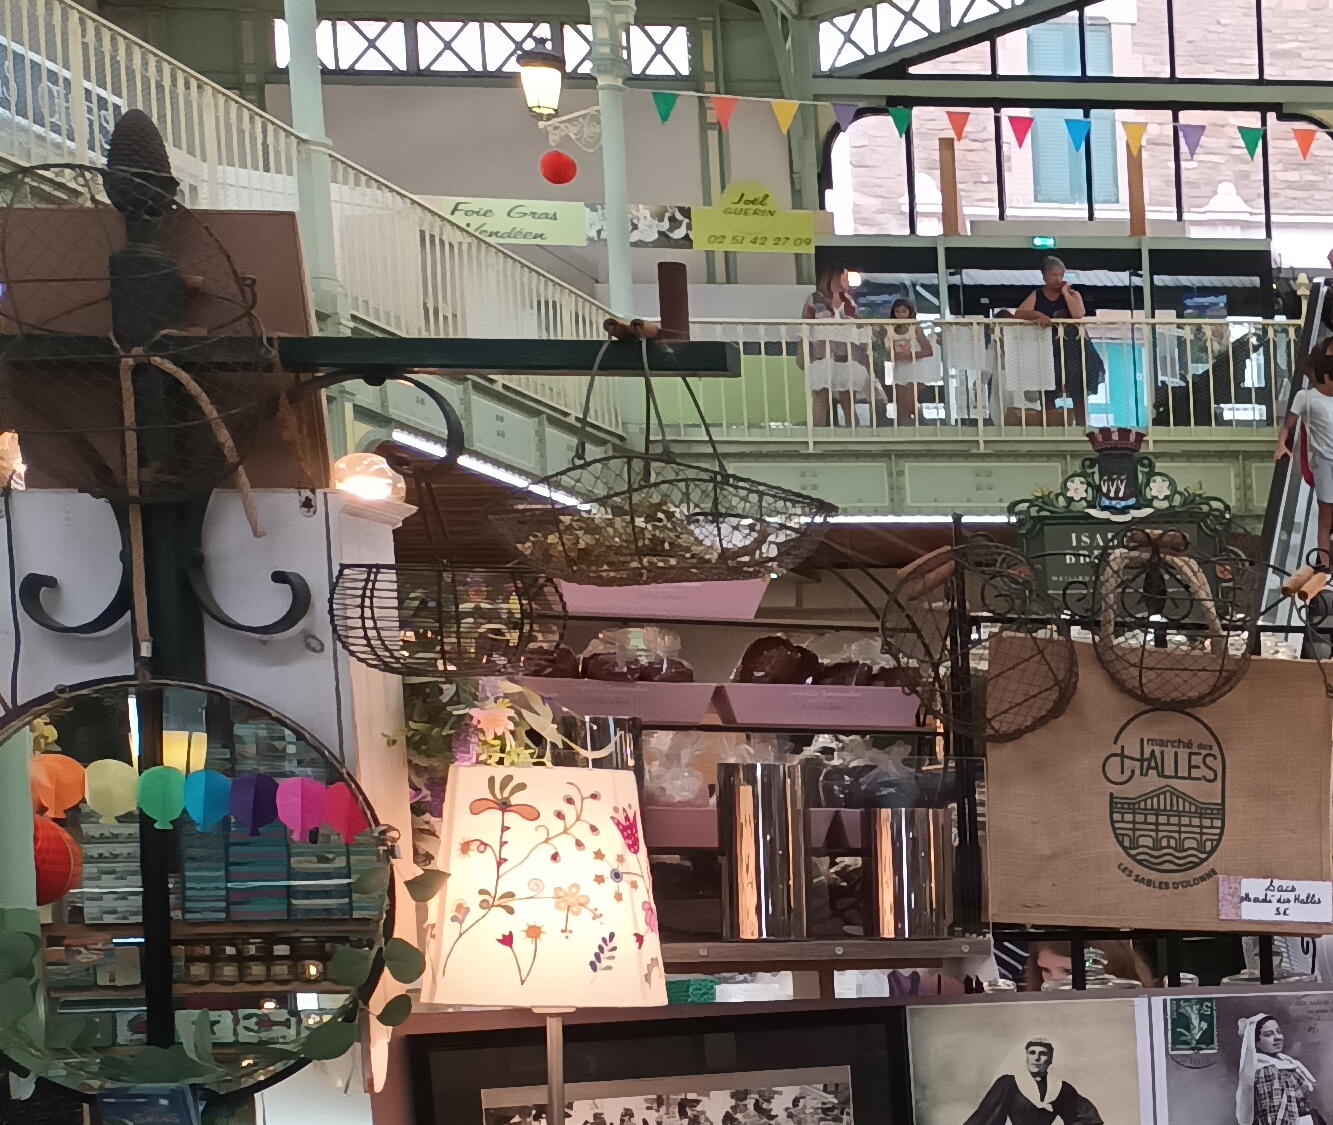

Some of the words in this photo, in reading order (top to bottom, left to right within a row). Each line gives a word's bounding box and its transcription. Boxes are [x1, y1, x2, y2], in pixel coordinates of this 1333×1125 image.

[449, 201, 496, 218] Foie
[505, 203, 559, 221] Gras
[722, 206, 778, 218] GUERIN
[1146, 738, 1194, 750] marché
[1196, 742, 1213, 751] des
[1101, 738, 1218, 786] HALLES
[1117, 862, 1134, 878] LES
[1133, 873, 1171, 891] SABLES
